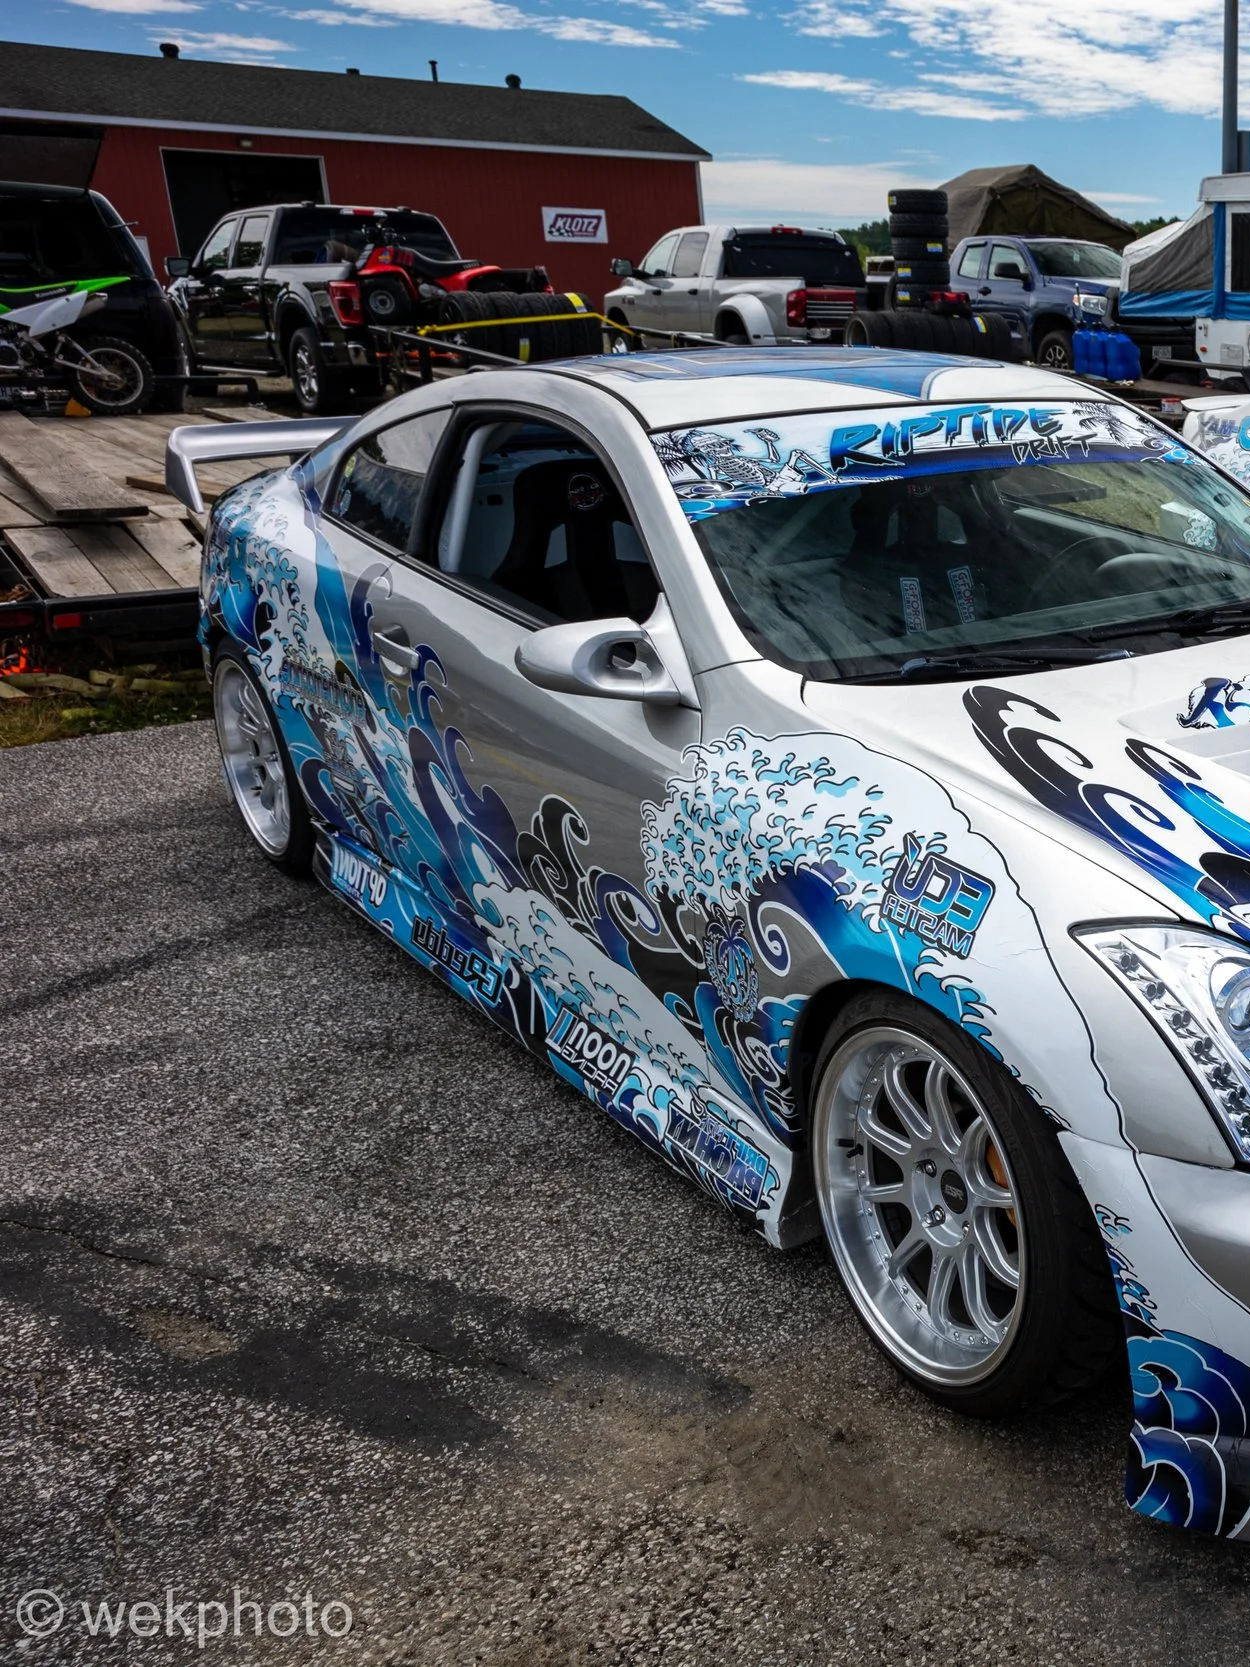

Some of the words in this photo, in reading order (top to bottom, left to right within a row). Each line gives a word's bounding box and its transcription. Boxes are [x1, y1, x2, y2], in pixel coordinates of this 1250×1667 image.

[555, 217, 598, 233] KLOTZ
[829, 405, 1066, 473] RIPTIDE
[1010, 433, 1098, 465] DRIFT
